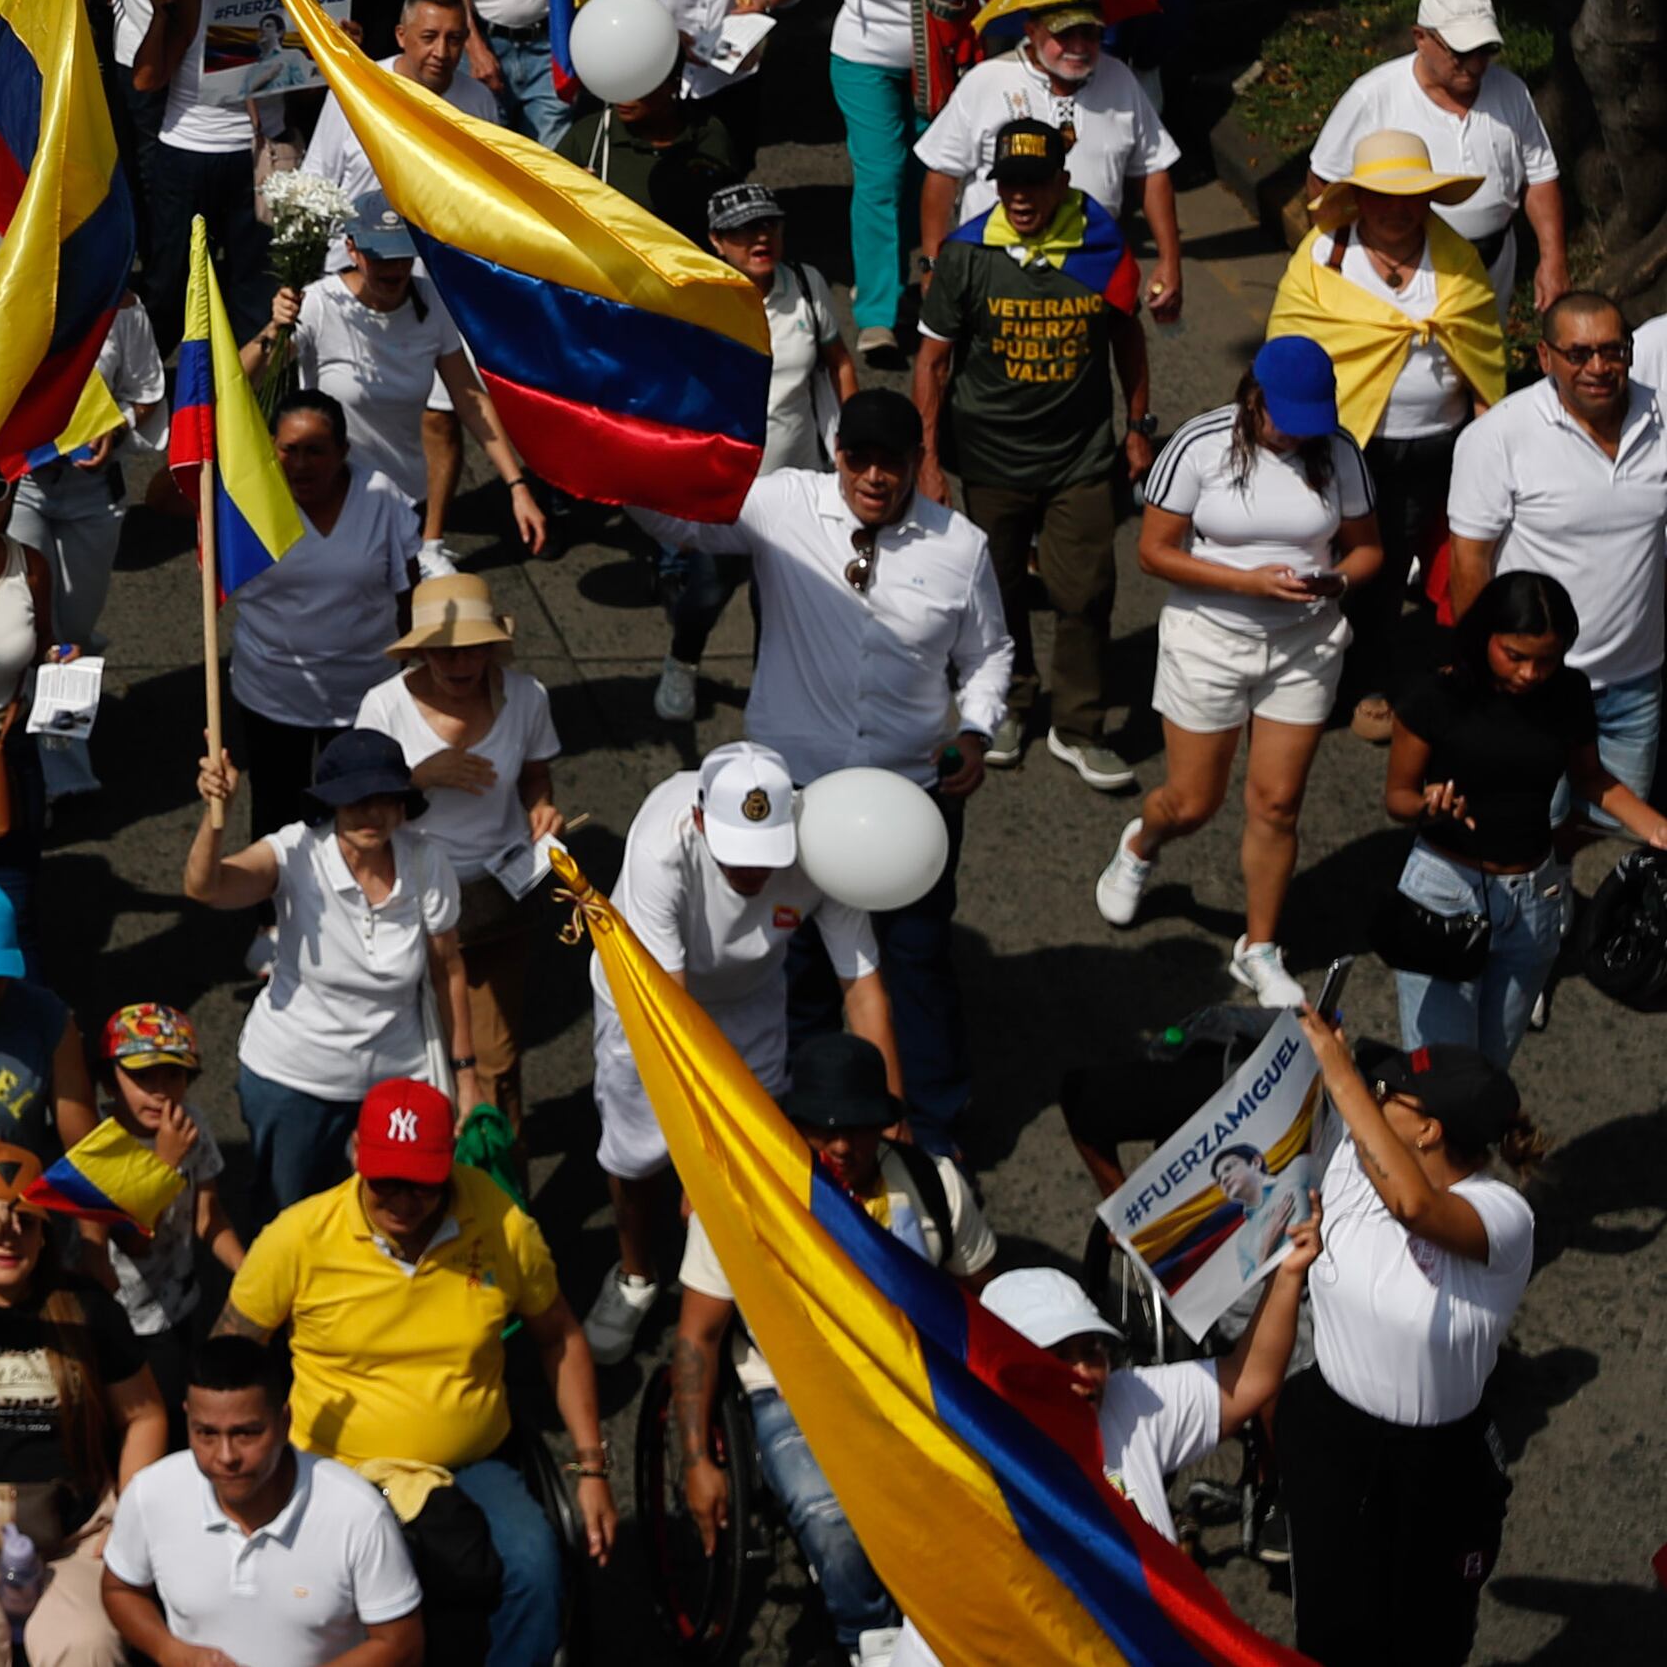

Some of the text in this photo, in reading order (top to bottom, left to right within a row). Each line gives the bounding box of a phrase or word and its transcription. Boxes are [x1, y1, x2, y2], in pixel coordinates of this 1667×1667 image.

[987, 295, 1102, 318] VETERANO
[1000, 319, 1088, 339] FUERZA
[1005, 360, 1077, 382] VALLE
[387, 1107, 419, 1142] NY
[1123, 1035, 1302, 1228] #FUERZAMIGUEL
